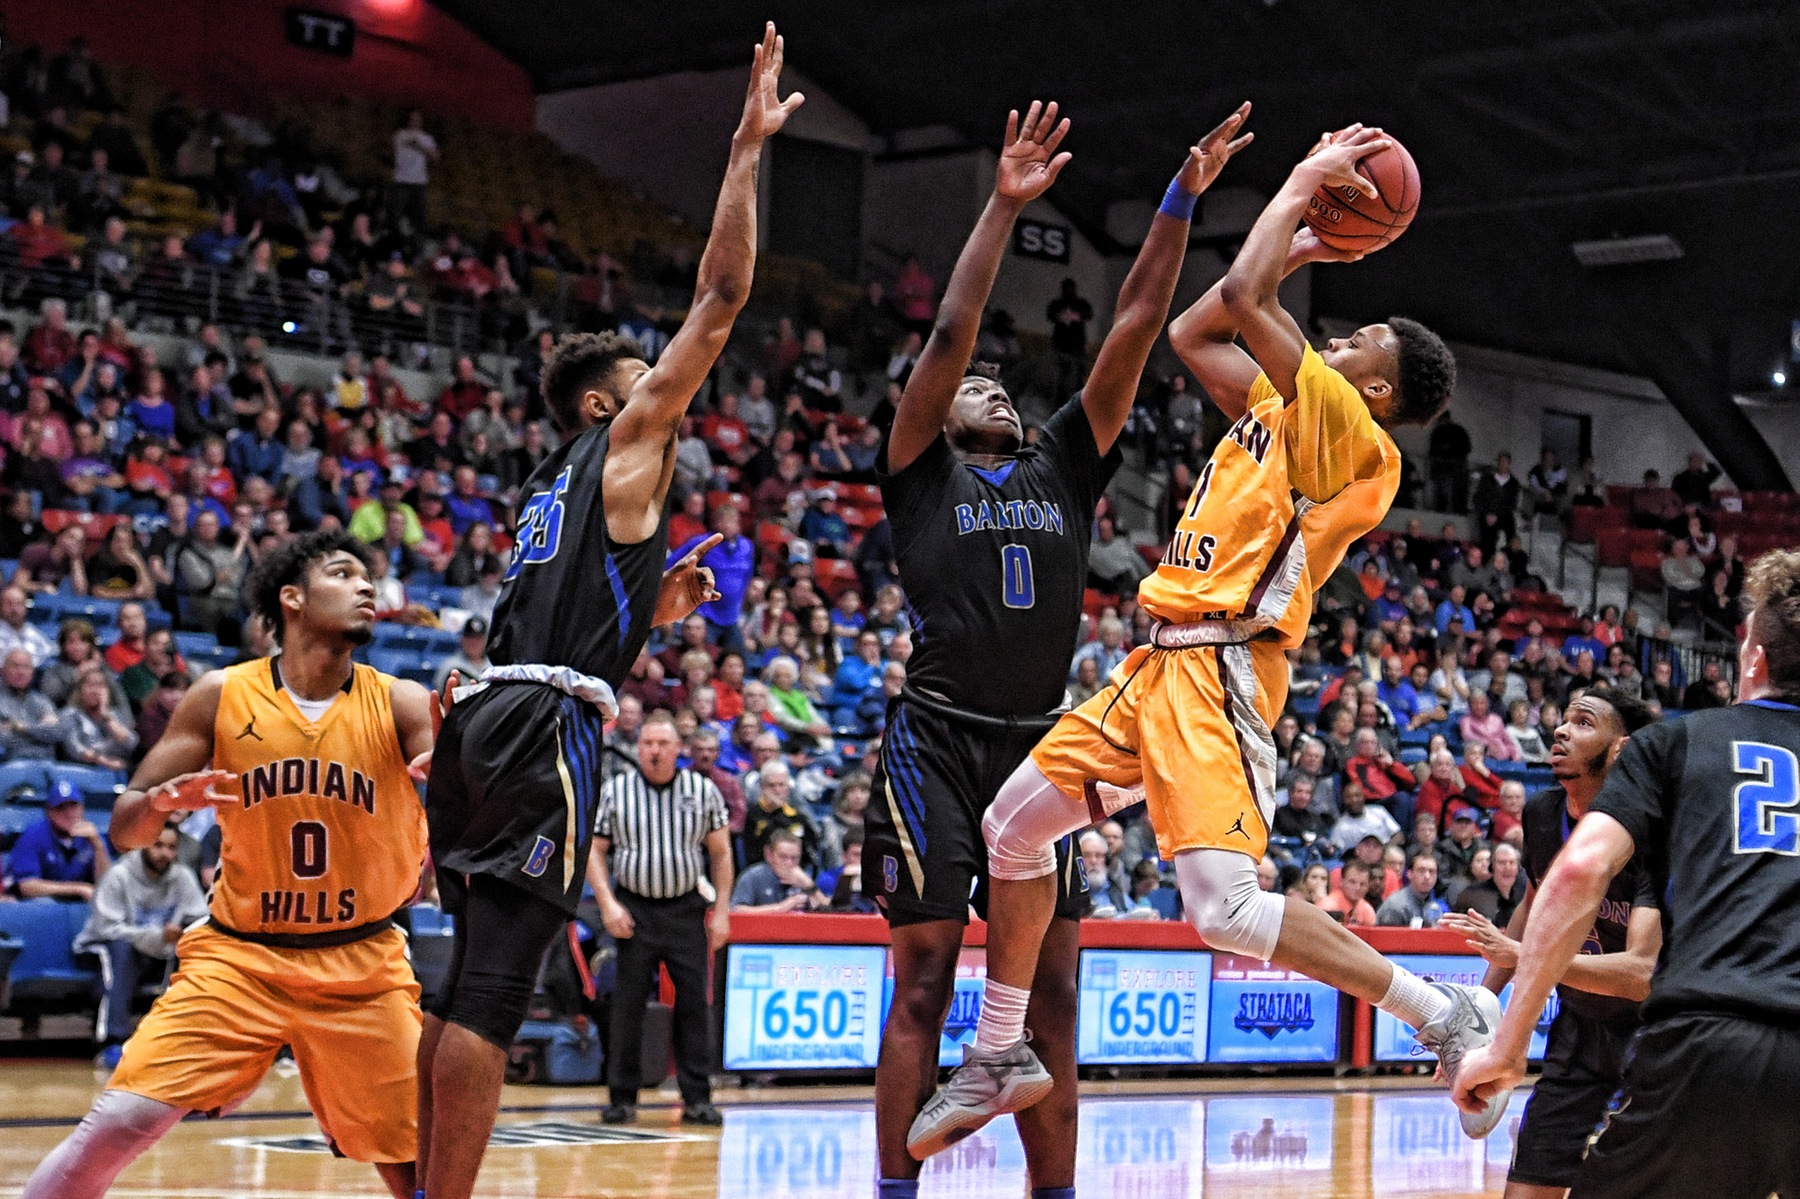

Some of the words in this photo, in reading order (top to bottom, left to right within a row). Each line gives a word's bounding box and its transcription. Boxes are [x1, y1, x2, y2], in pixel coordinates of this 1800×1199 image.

[296, 13, 347, 47] TT
[1021, 225, 1066, 256] SS
[1001, 543, 1035, 610] 0
[241, 757, 375, 817] INDIAN
[1731, 740, 1800, 857] 2
[290, 819, 329, 880] 0
[521, 834, 556, 878] B
[883, 854, 899, 893] B
[260, 887, 356, 925] HILLS
[1121, 969, 1198, 988] EXPLORE
[762, 989, 849, 1040] 650
[1109, 991, 1181, 1037] 650
[1239, 992, 1313, 1021] STRATACA
